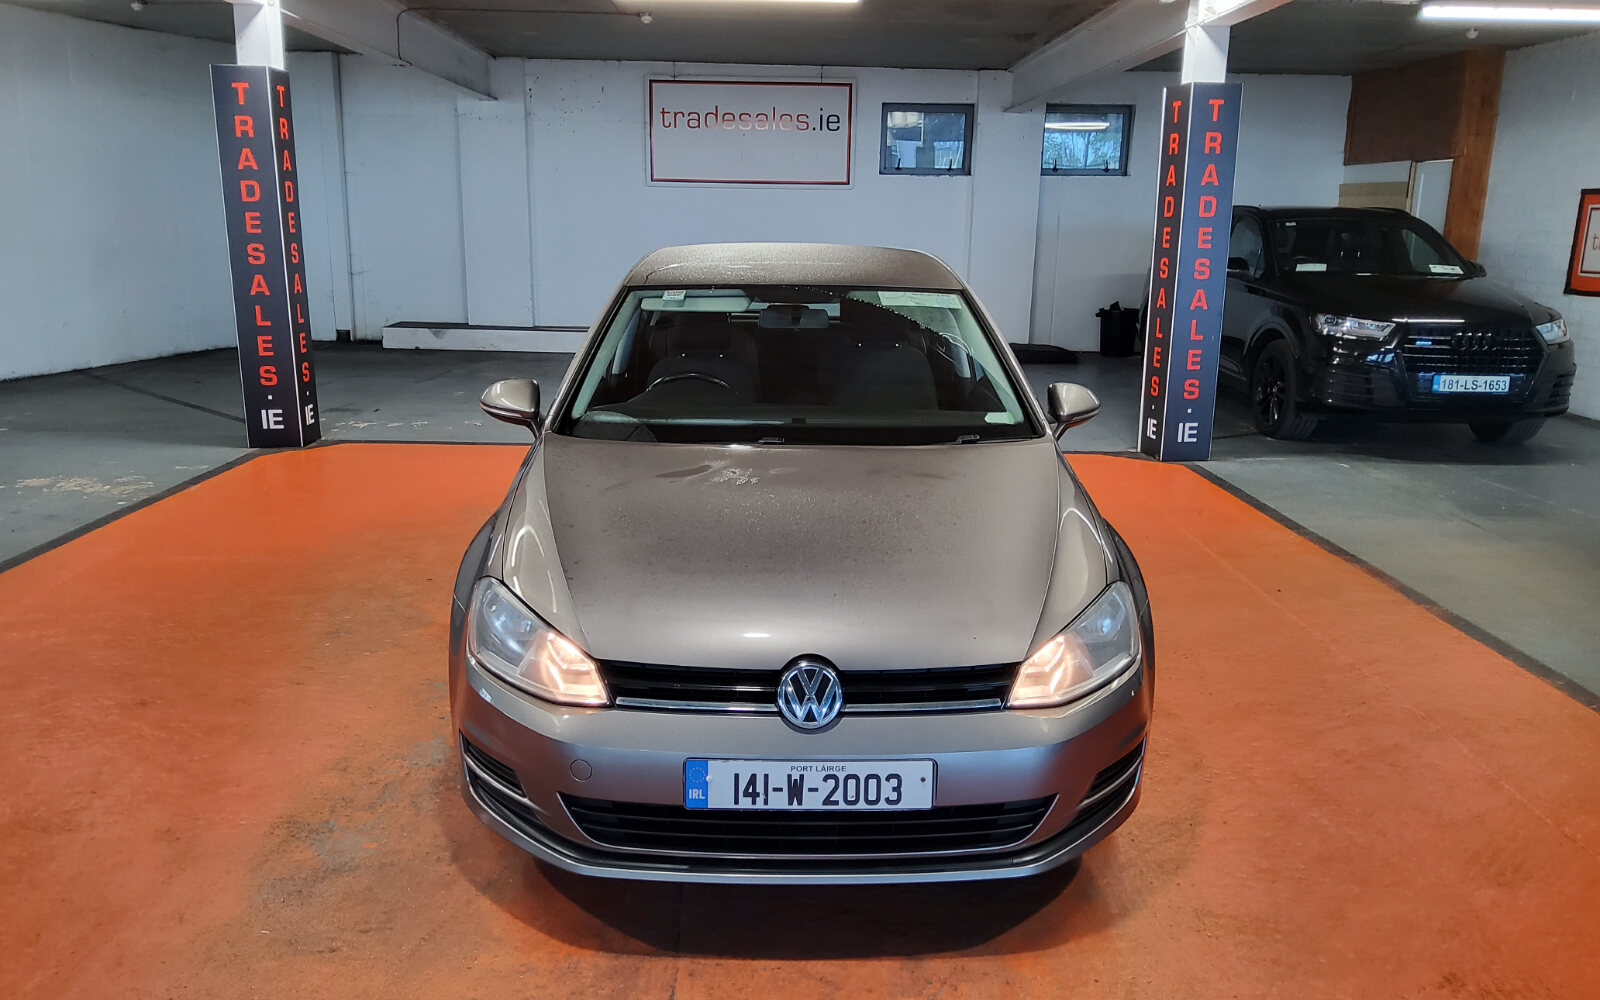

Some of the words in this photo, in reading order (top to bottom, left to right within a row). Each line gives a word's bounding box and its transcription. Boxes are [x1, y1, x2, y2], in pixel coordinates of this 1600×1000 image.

[660, 105, 841, 132] tradesales.ie
[1441, 378, 1507, 391] 181-LS-1653
[790, 765, 814, 773] PORT
[815, 764, 847, 773] LÁIRGE
[688, 788, 706, 800] IRL
[733, 773, 903, 806] 141-W-2003
